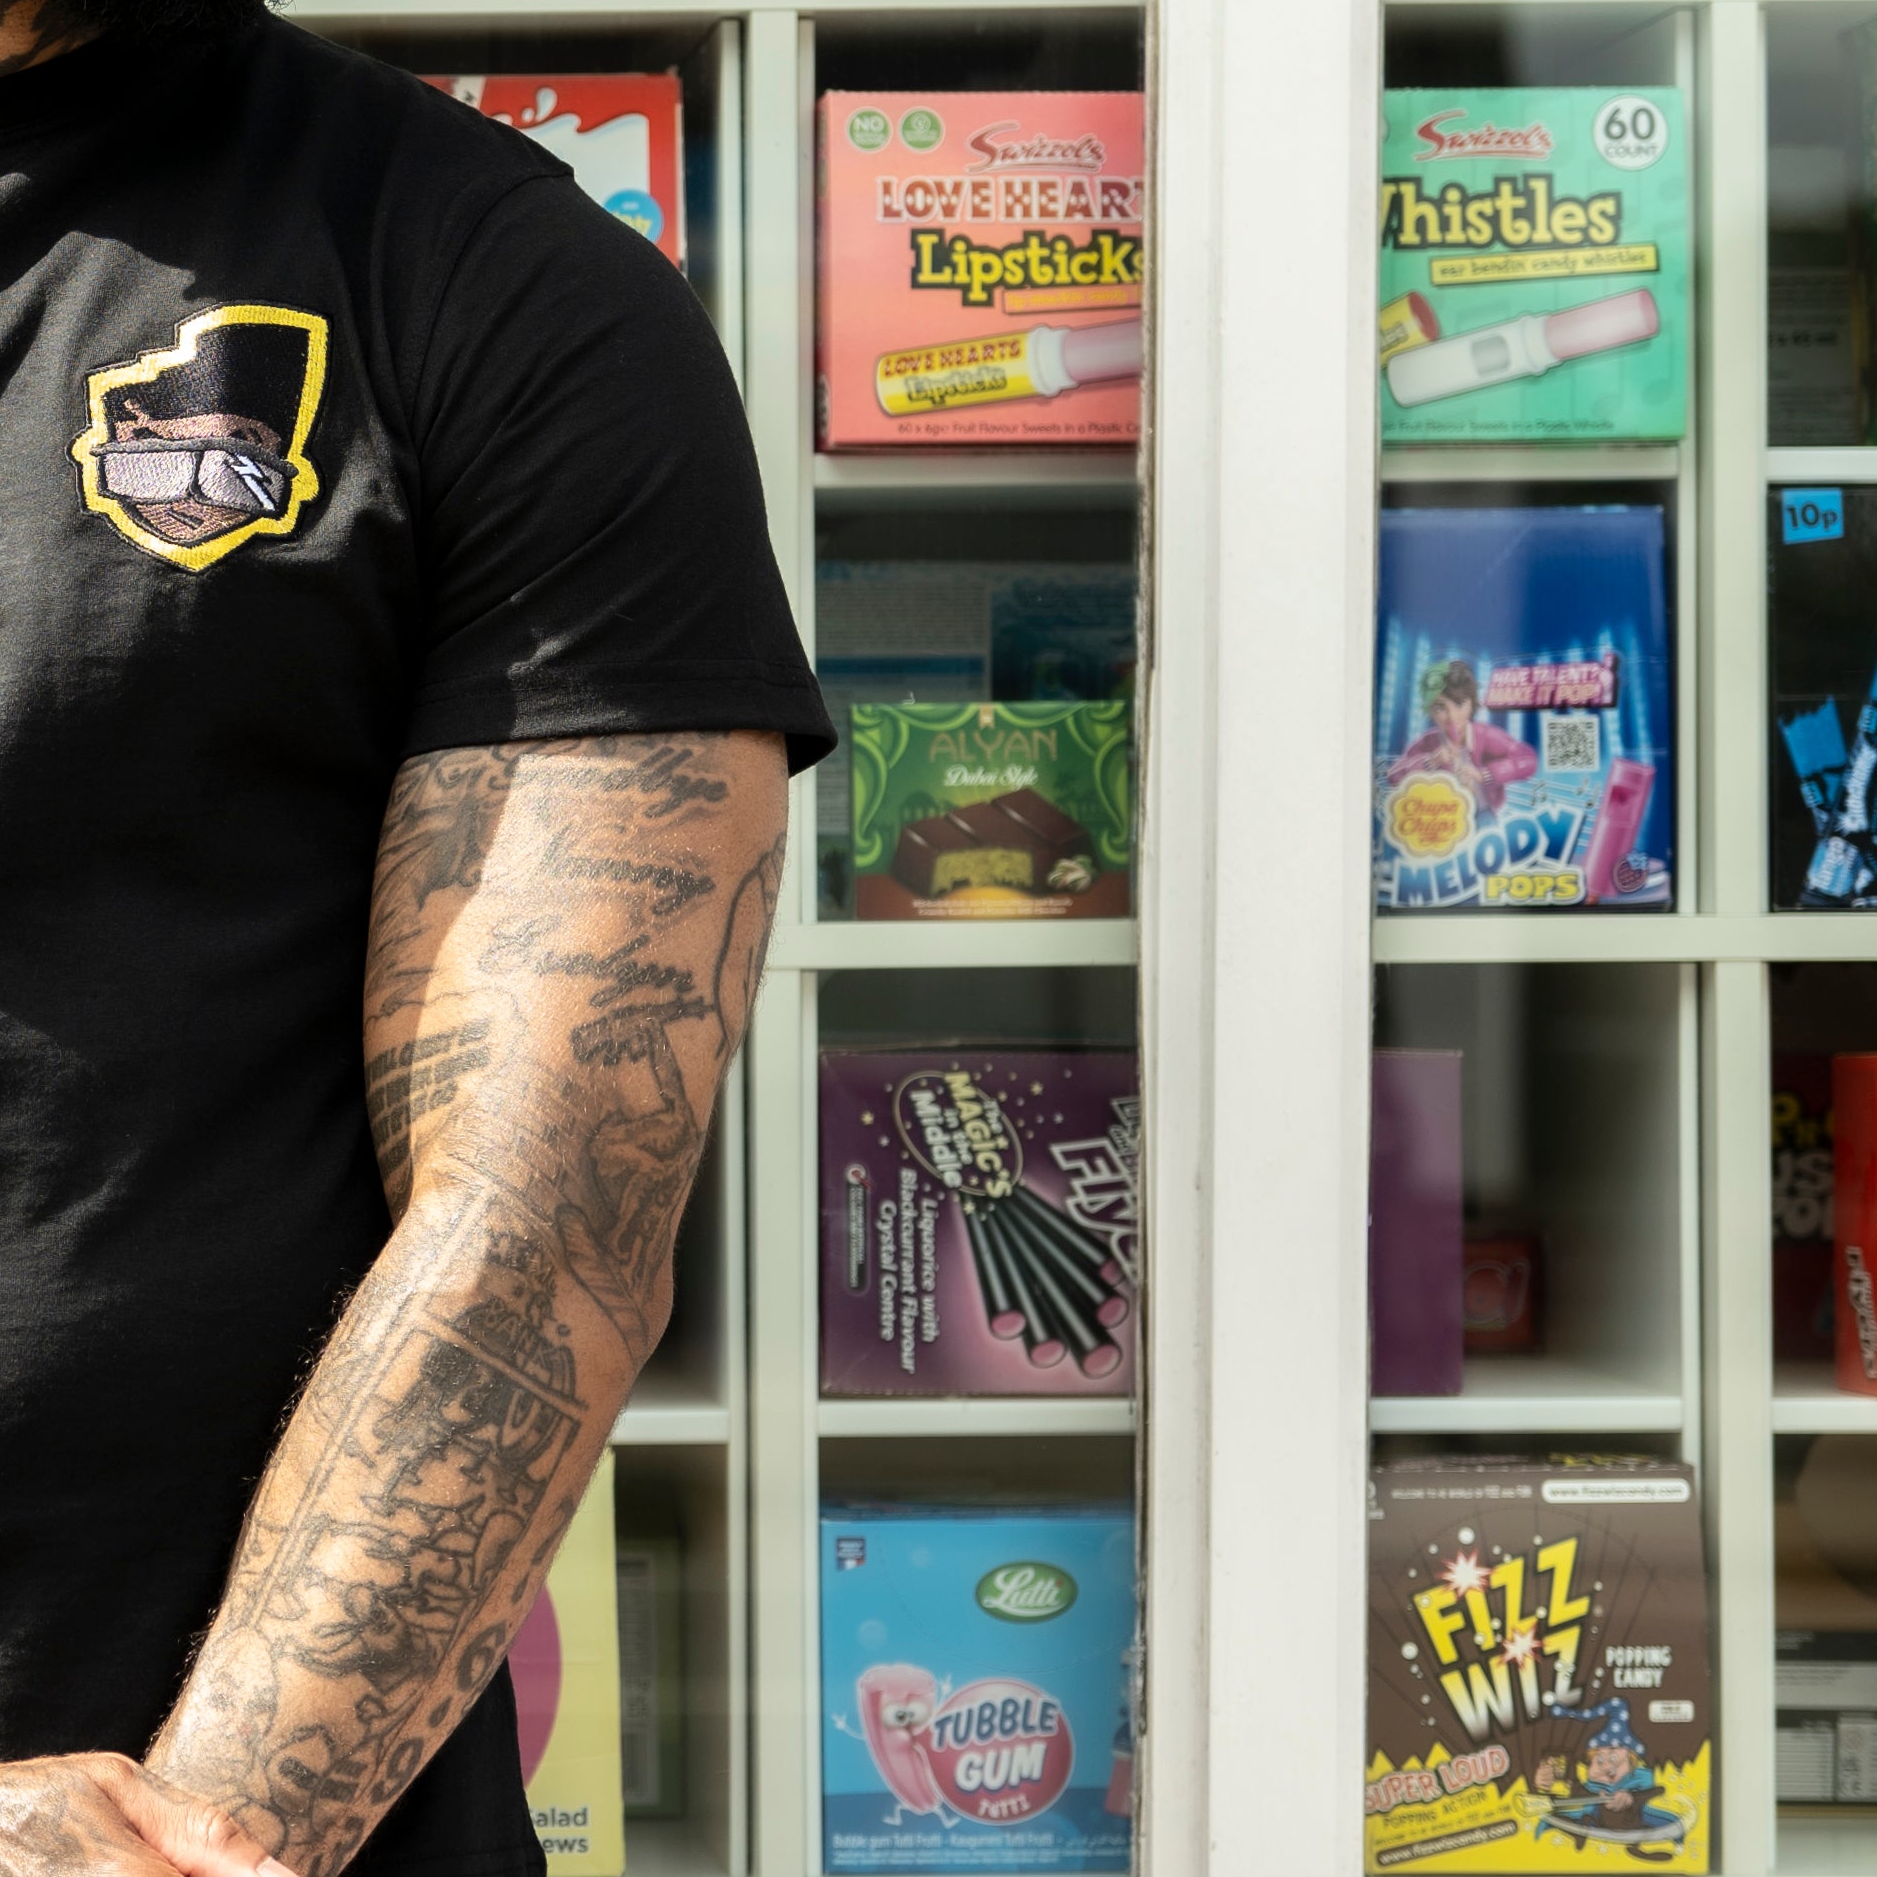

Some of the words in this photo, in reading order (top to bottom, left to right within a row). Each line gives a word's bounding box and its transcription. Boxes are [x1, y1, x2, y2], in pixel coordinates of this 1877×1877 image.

[1604, 107, 1657, 141] 60
[1605, 144, 1657, 157] COUNT
[878, 178, 995, 221] LOVE
[1439, 263, 1464, 277] ear
[1531, 253, 1578, 274] candy
[1583, 249, 1648, 268] whistles
[883, 351, 933, 378] LOVE
[940, 339, 1021, 367] HEARTS
[1785, 501, 1840, 533] 10p
[928, 729, 1058, 762] ALYAN
[943, 765, 998, 788] Dubai
[999, 765, 1039, 790] Style
[1394, 807, 1579, 905] MELODY
[1486, 874, 1579, 899] POPS
[910, 1089, 963, 1189] Middle
[875, 1200, 897, 1271] Crystal
[899, 1167, 919, 1288] Blackcurrant
[919, 1198, 939, 1292] Liquorice
[879, 1276, 897, 1342] Centre
[900, 1290, 920, 1374] Flavour
[922, 1294, 939, 1343] with
[984, 1568, 1062, 1615] Lutti
[1414, 1537, 1591, 1665] FIZZ
[1606, 1646, 1672, 1669] POPPING
[1613, 1668, 1664, 1689] CANDY
[1440, 1625, 1582, 1744] WIZ
[932, 1697, 1060, 1750] TUBBLE
[954, 1741, 1047, 1791] GUM
[1365, 1772, 1441, 1814] SUPER
[1442, 1745, 1509, 1791] LOUD
[977, 1795, 1031, 1818] TUTTI
